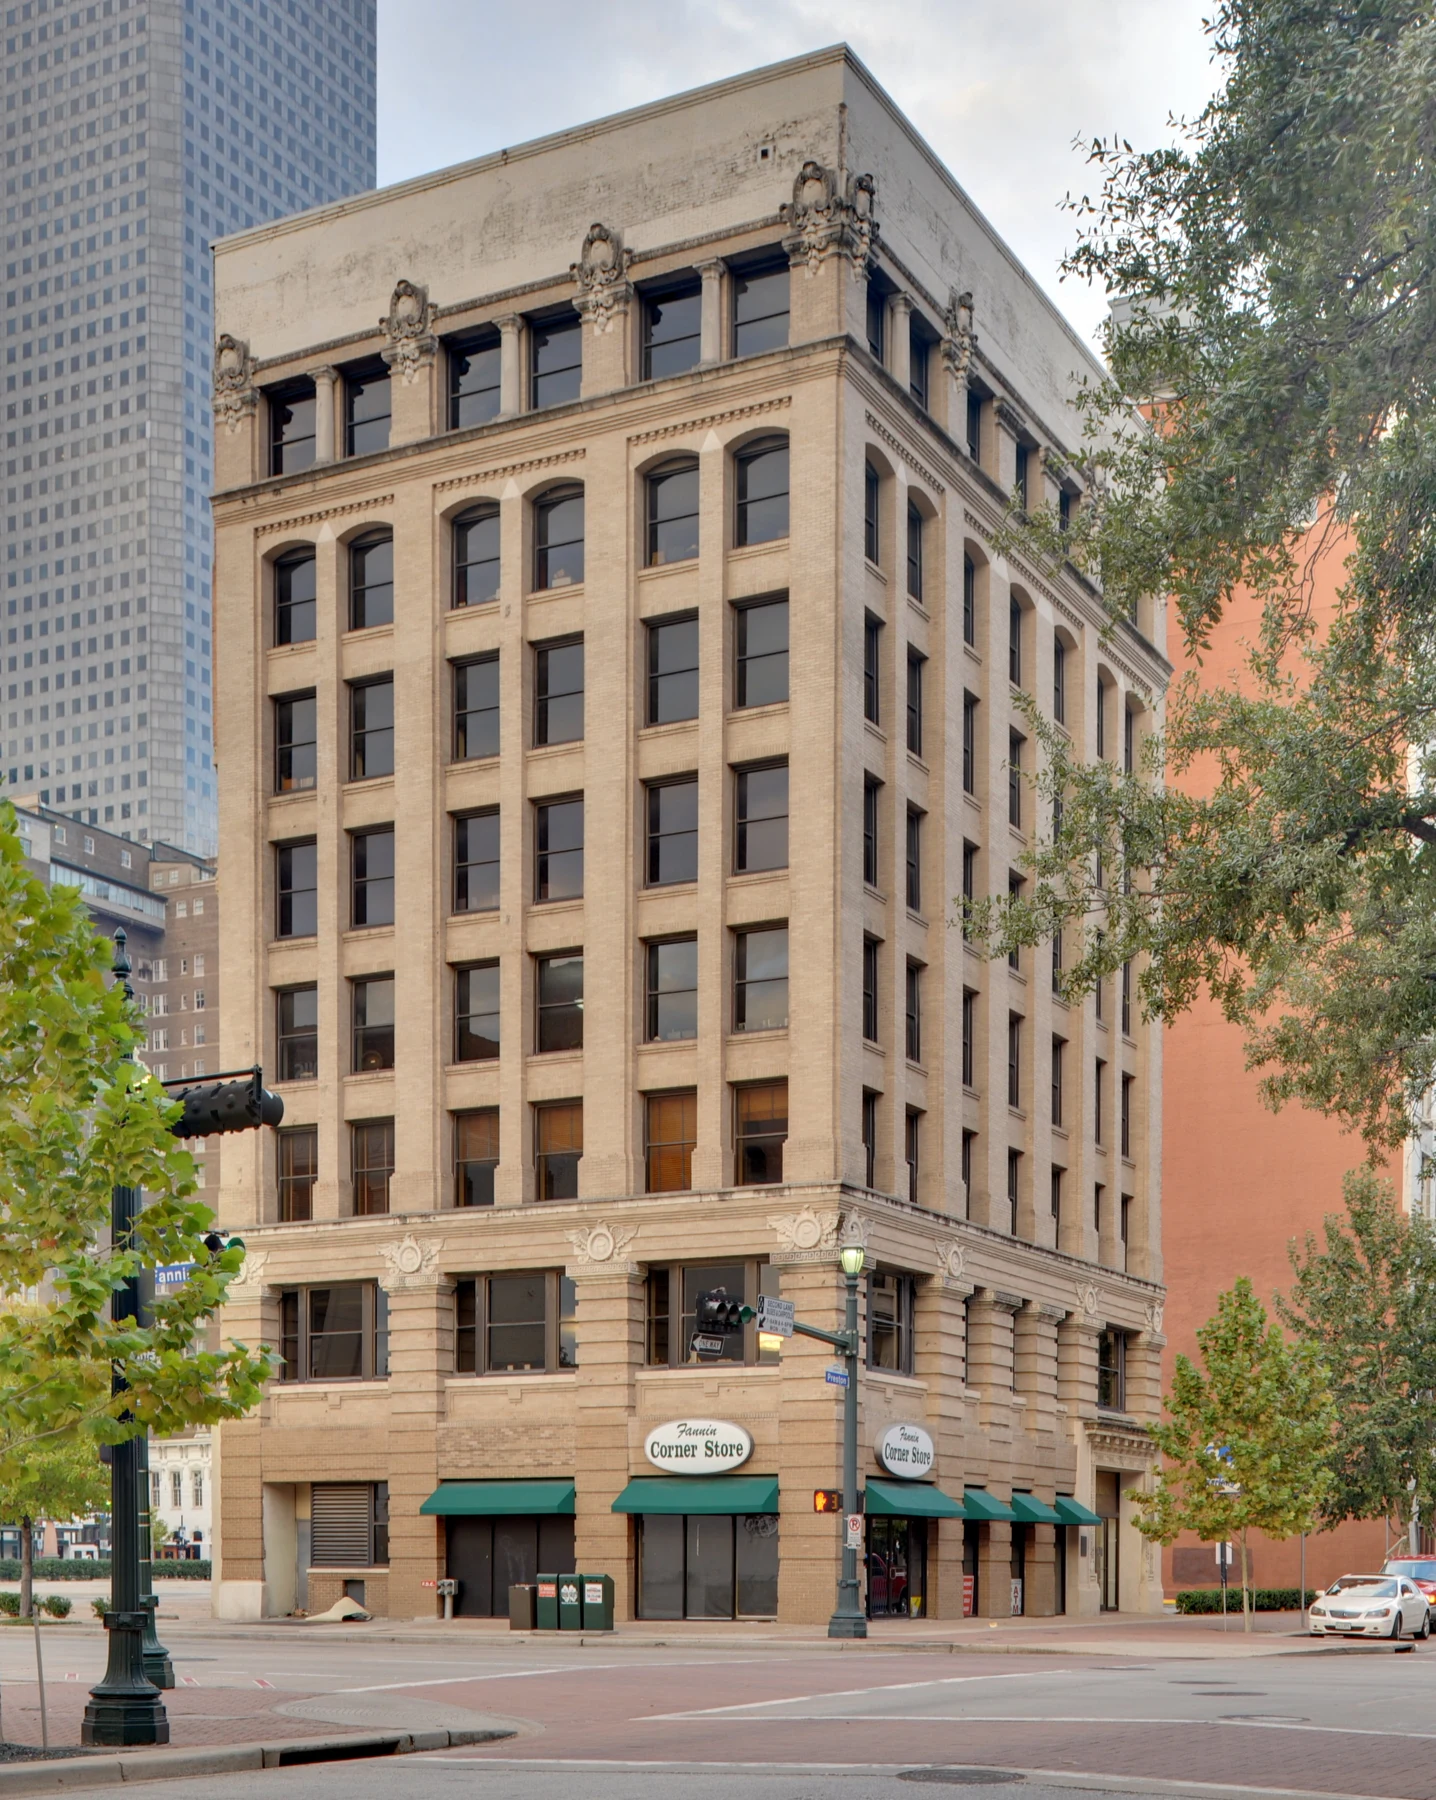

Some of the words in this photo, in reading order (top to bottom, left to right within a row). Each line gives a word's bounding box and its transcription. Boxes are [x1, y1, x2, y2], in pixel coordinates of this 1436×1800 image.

[155, 1267, 190, 1283] anni
[710, 1341, 720, 1349] WAY
[827, 1373, 847, 1385] Preston
[676, 1422, 717, 1439] Fannin
[899, 1426, 919, 1442] Fannin
[650, 1441, 698, 1458] Corner
[704, 1440, 744, 1458] Store
[885, 1443, 909, 1462] Corner
[911, 1446, 931, 1466] Store
